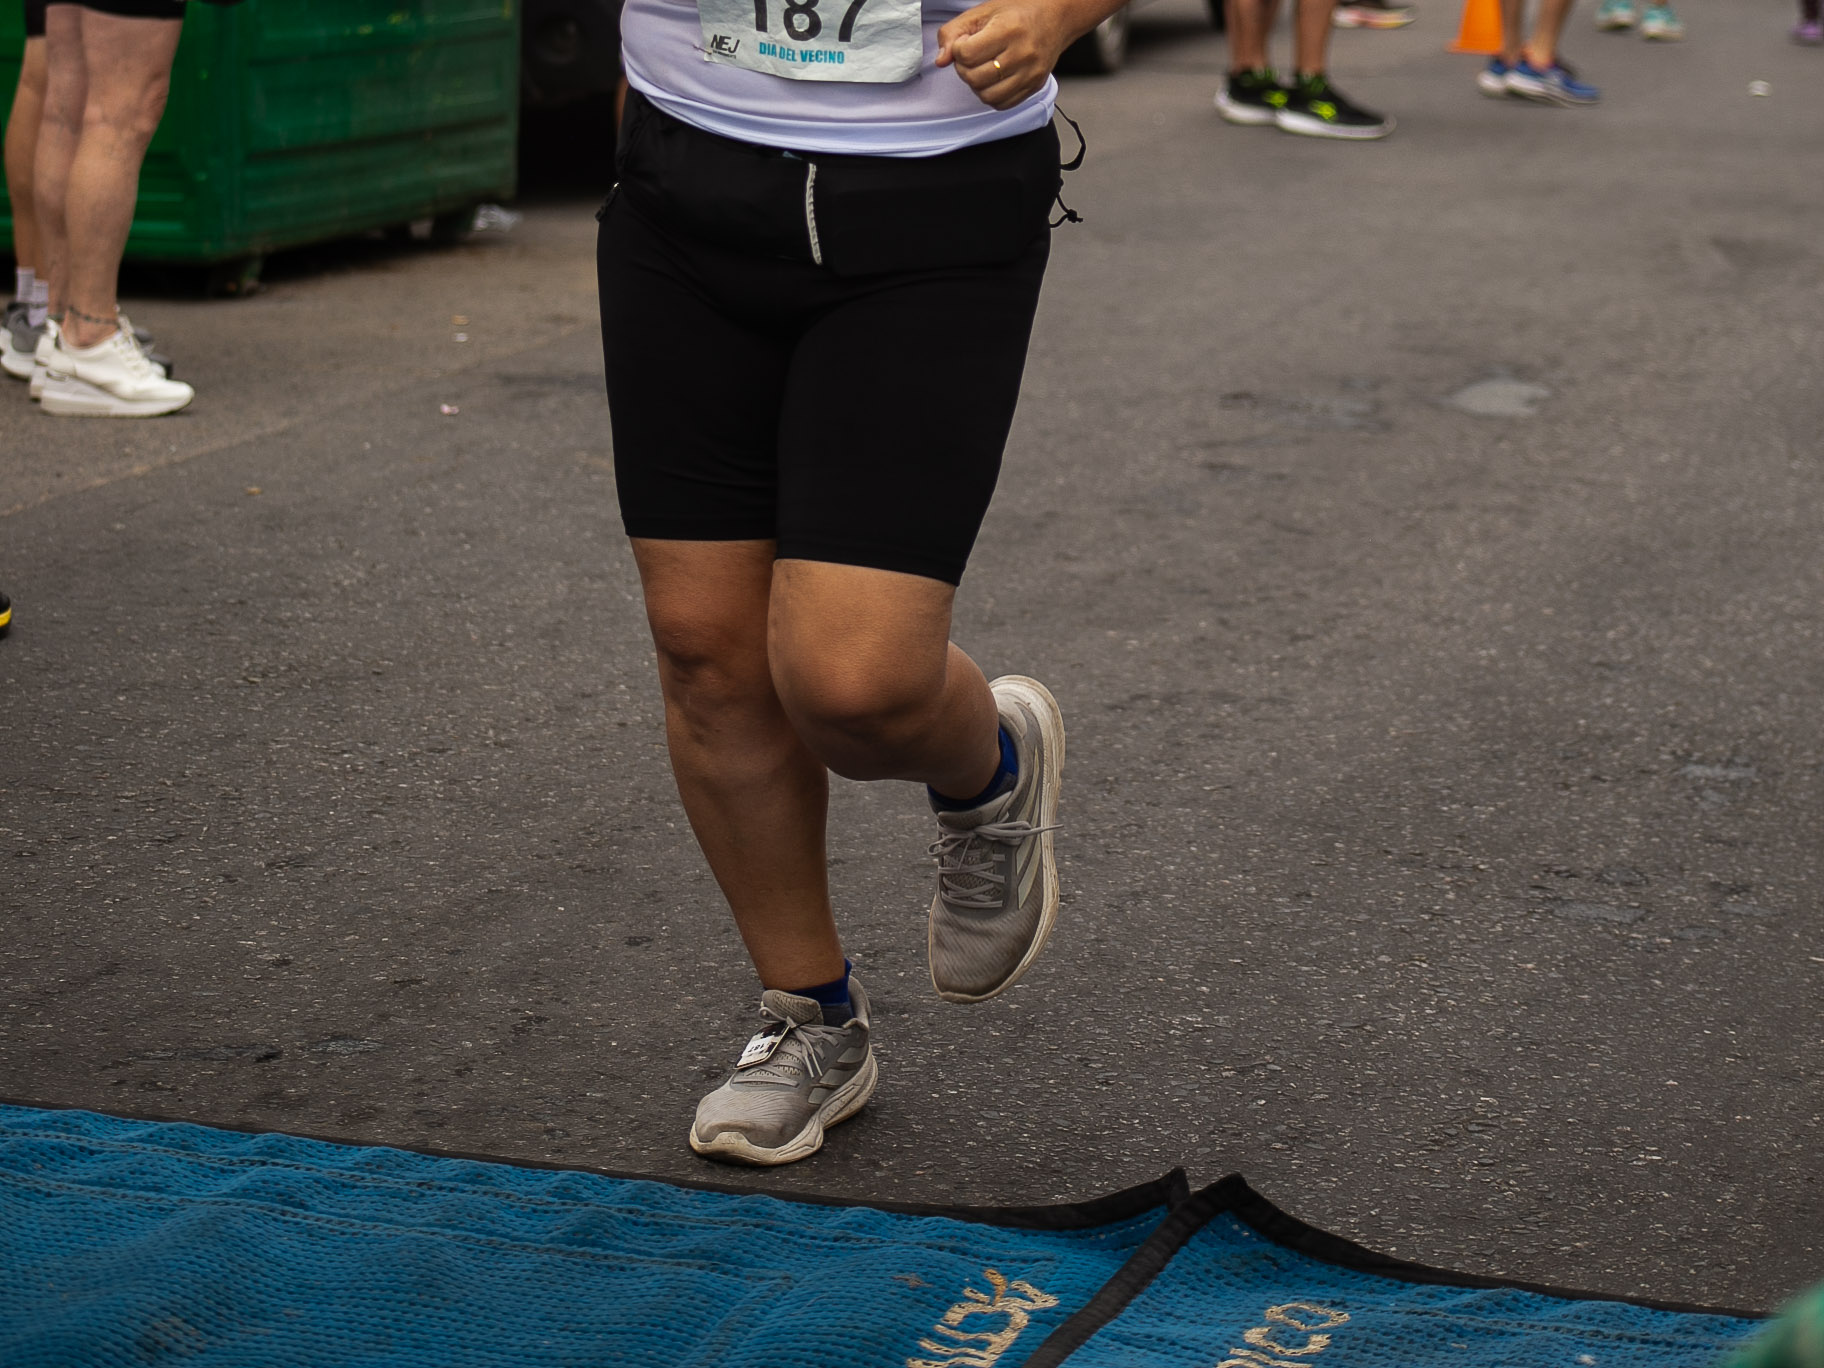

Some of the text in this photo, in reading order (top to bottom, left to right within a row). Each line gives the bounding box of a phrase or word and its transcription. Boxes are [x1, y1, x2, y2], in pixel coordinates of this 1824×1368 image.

[710, 34, 740, 53] NEJ
[759, 42, 845, 65] DIA DEL VECINO
